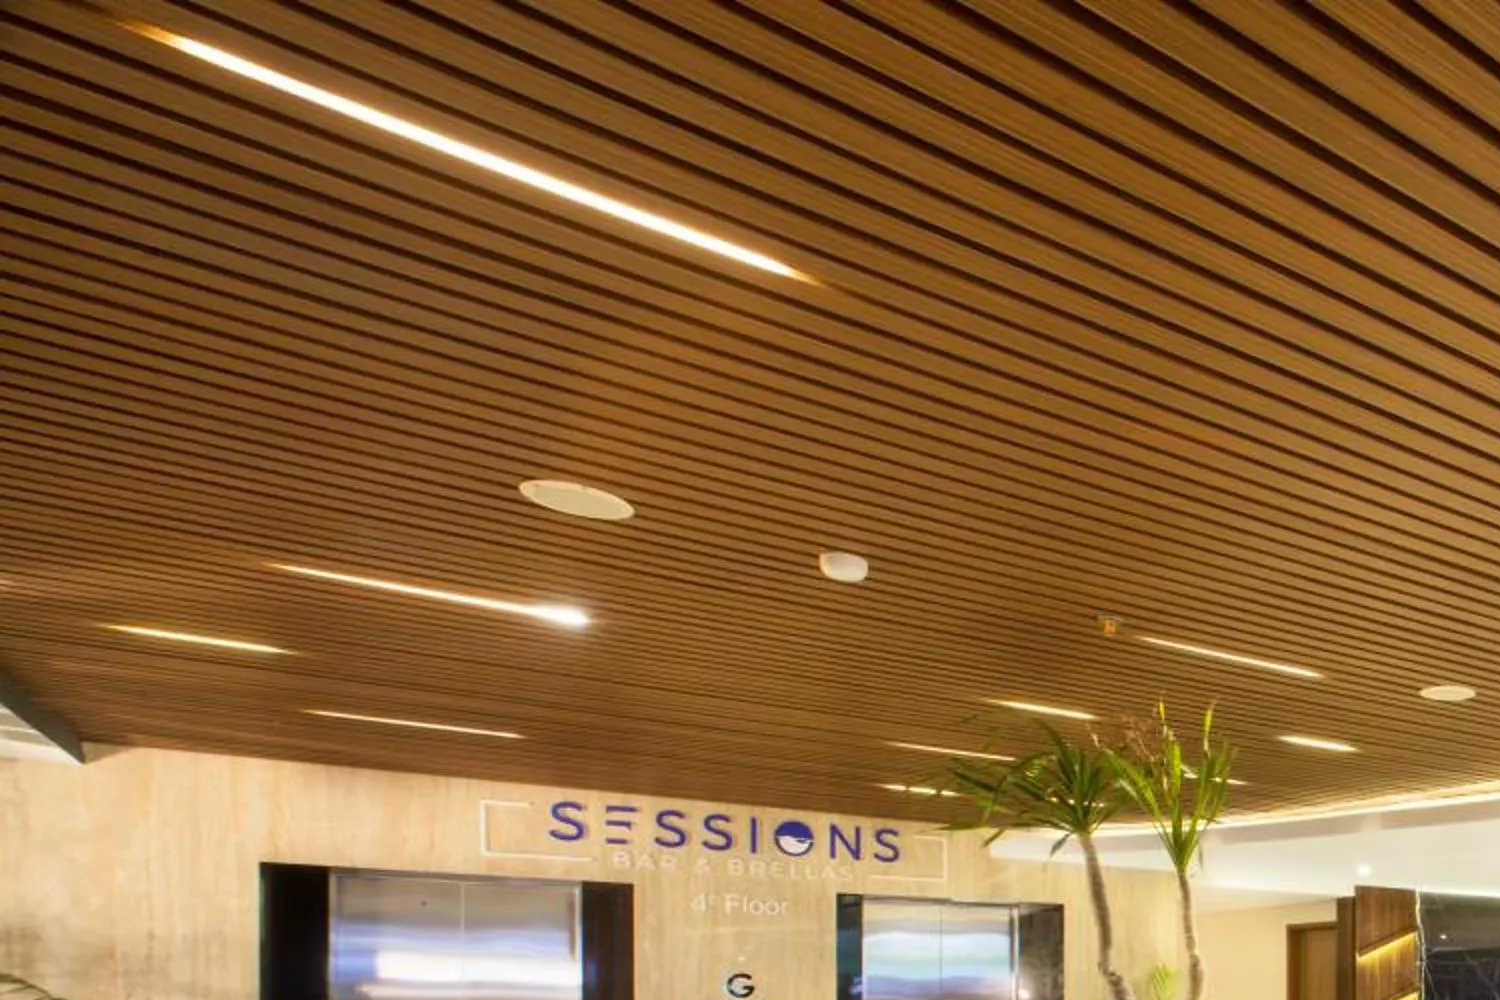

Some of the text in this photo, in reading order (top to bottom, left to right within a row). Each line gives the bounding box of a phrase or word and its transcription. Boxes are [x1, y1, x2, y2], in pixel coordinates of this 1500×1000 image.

[549, 801, 901, 863] SESSIONS
[611, 852, 678, 872] BAR
[727, 858, 855, 881] BRELLAS
[724, 893, 789, 916] Floor
[726, 973, 755, 998] G
